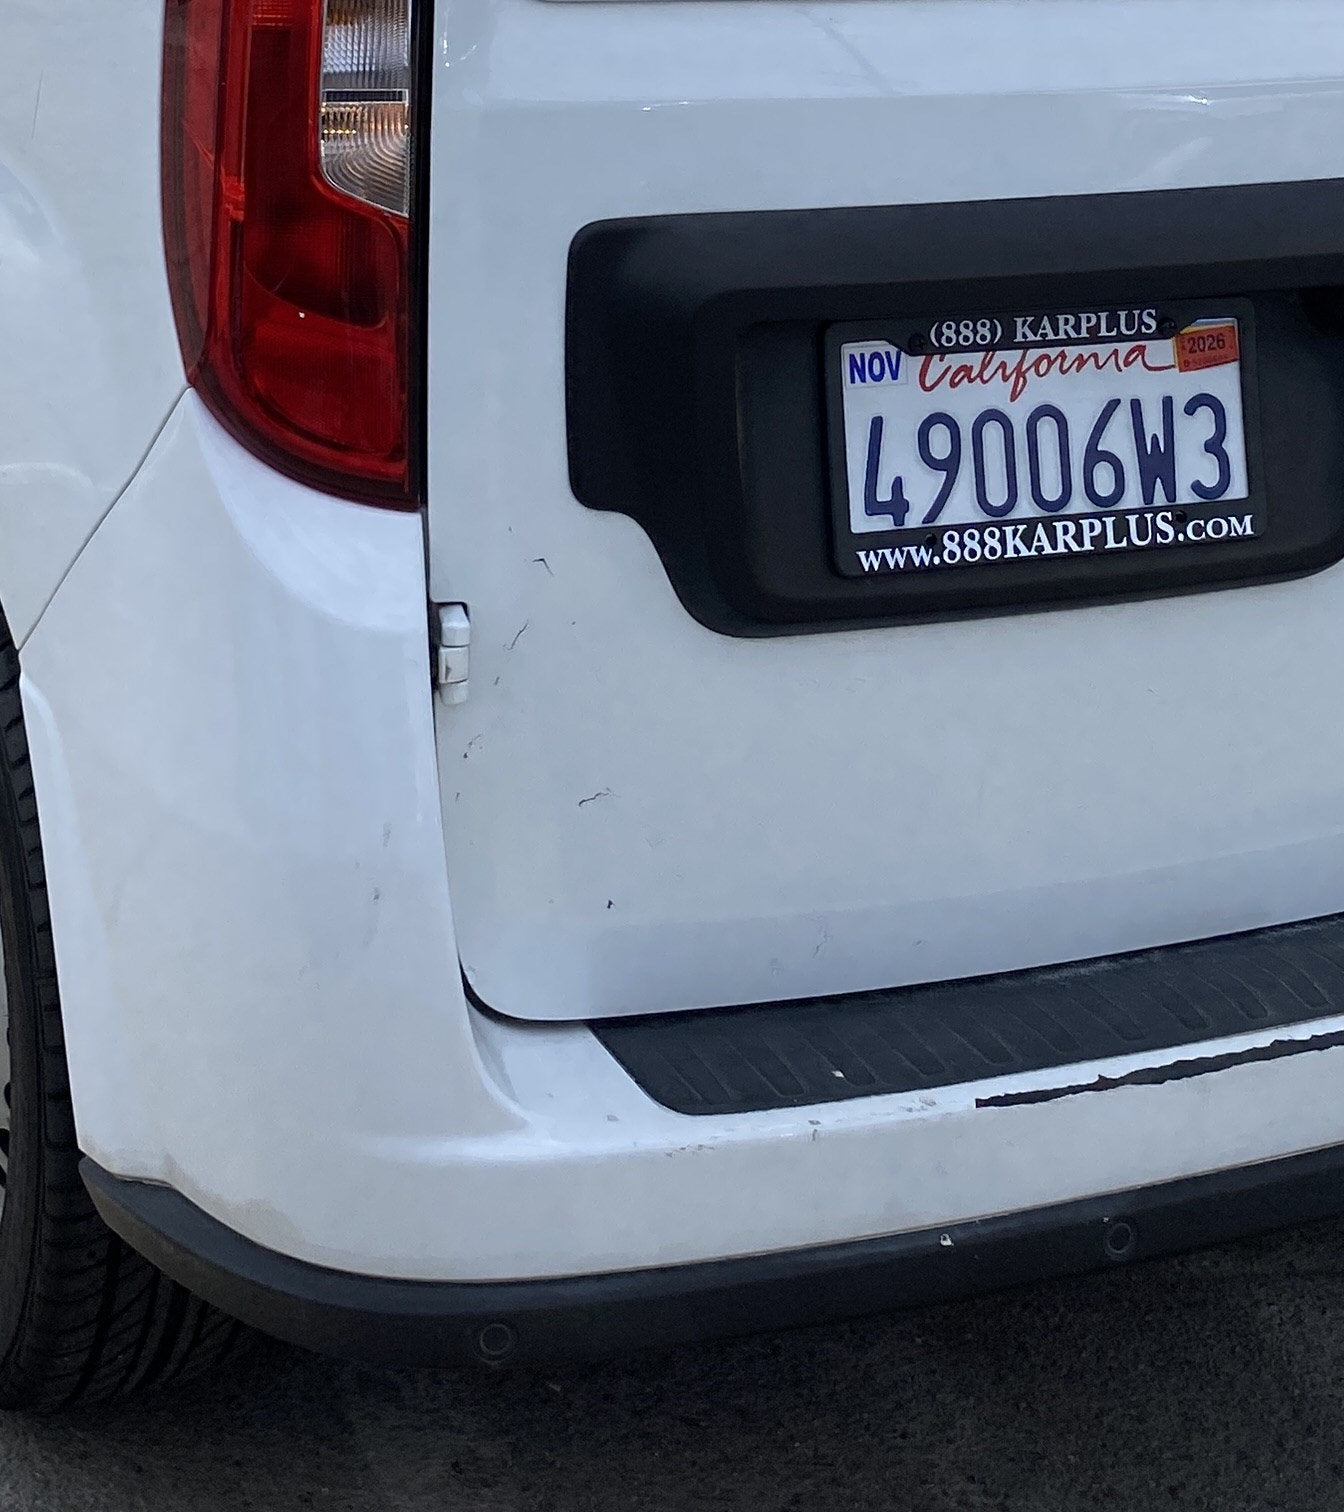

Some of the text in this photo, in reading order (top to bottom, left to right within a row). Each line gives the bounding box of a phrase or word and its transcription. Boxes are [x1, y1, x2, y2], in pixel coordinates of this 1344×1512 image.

[929, 308, 1157, 349] (888) KARPLUS
[1188, 333, 1226, 354] 2026
[849, 350, 902, 385] NOV
[918, 344, 1176, 402] California
[864, 393, 1232, 527] 49006W3
